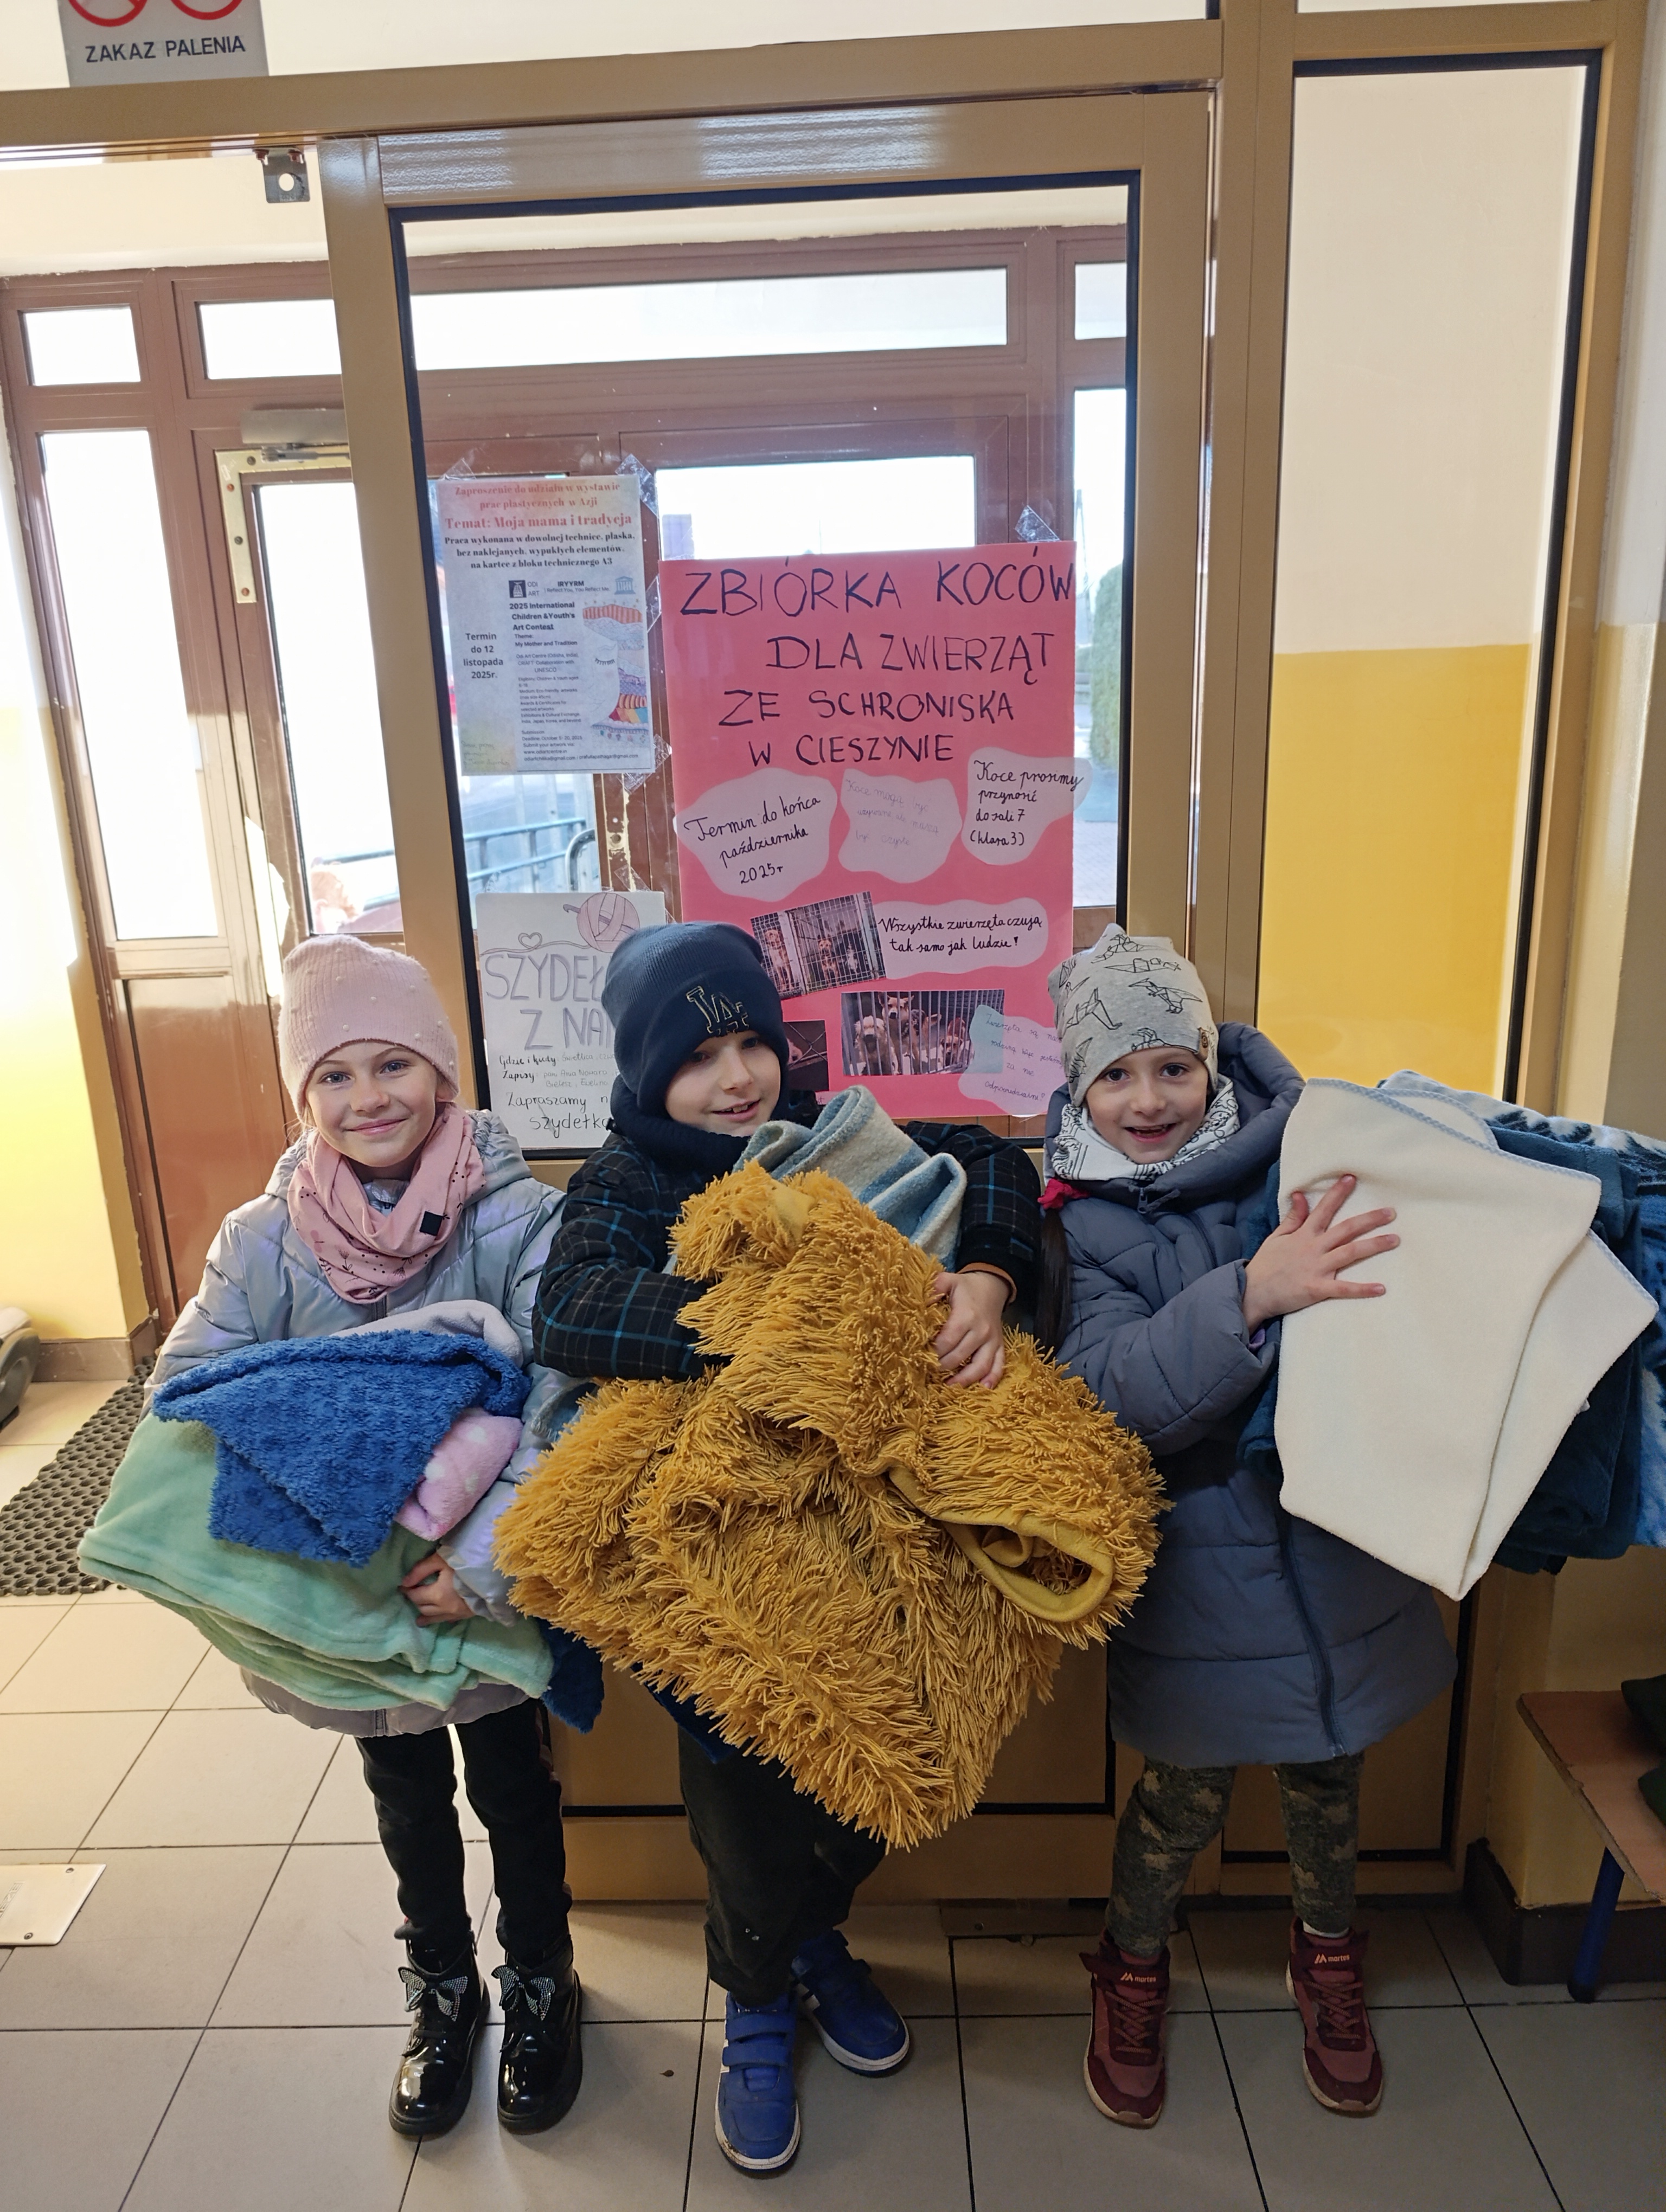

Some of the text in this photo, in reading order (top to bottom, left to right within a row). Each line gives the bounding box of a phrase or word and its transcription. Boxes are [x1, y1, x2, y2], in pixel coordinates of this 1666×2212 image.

[85, 35, 246, 63] ZAKAZ PALENIA
[456, 485, 512, 497] Zaproszenie
[515, 485, 526, 493] do
[528, 484, 563, 493] udziału
[576, 482, 620, 493] wystawie
[480, 501, 501, 511] prac
[503, 498, 564, 510] plastycznych
[581, 497, 597, 507] Azji
[445, 513, 631, 530] Temat: Moja mama i tradycja
[471, 536, 514, 545] wykonana
[525, 534, 563, 543] dowolnej
[529, 546, 574, 556] wypukłych
[483, 560, 510, 568] kartce
[544, 558, 599, 567] technicznego
[680, 545, 1075, 617] ZBIÓRKA KOCÓW
[465, 632, 497, 640] Termin
[463, 658, 503, 667] listopada
[766, 632, 1055, 685] DLA ZWIERZĄT
[719, 690, 1015, 726] ZE SCHRONISKA
[747, 734, 954, 767] W CIESZYNIE
[974, 760, 1084, 792] Koce prosimy
[978, 790, 1037, 804] przynosić
[683, 795, 821, 841] Termin do końca
[976, 808, 1025, 822] do sali 7
[719, 824, 809, 869] października
[739, 863, 784, 884] 2025r
[878, 914, 1042, 935] Wszystkie zwierzęta czują
[889, 938, 914, 952] tak
[917, 942, 944, 953] samo
[947, 937, 967, 956] jak
[485, 953, 611, 1002] SZYDEŁ
[520, 1007, 614, 1051] Z NA
[499, 1055, 524, 1069] Gdzie
[1007, 1062, 1015, 1071] za
[506, 1092, 586, 1114] Zapraszamy
